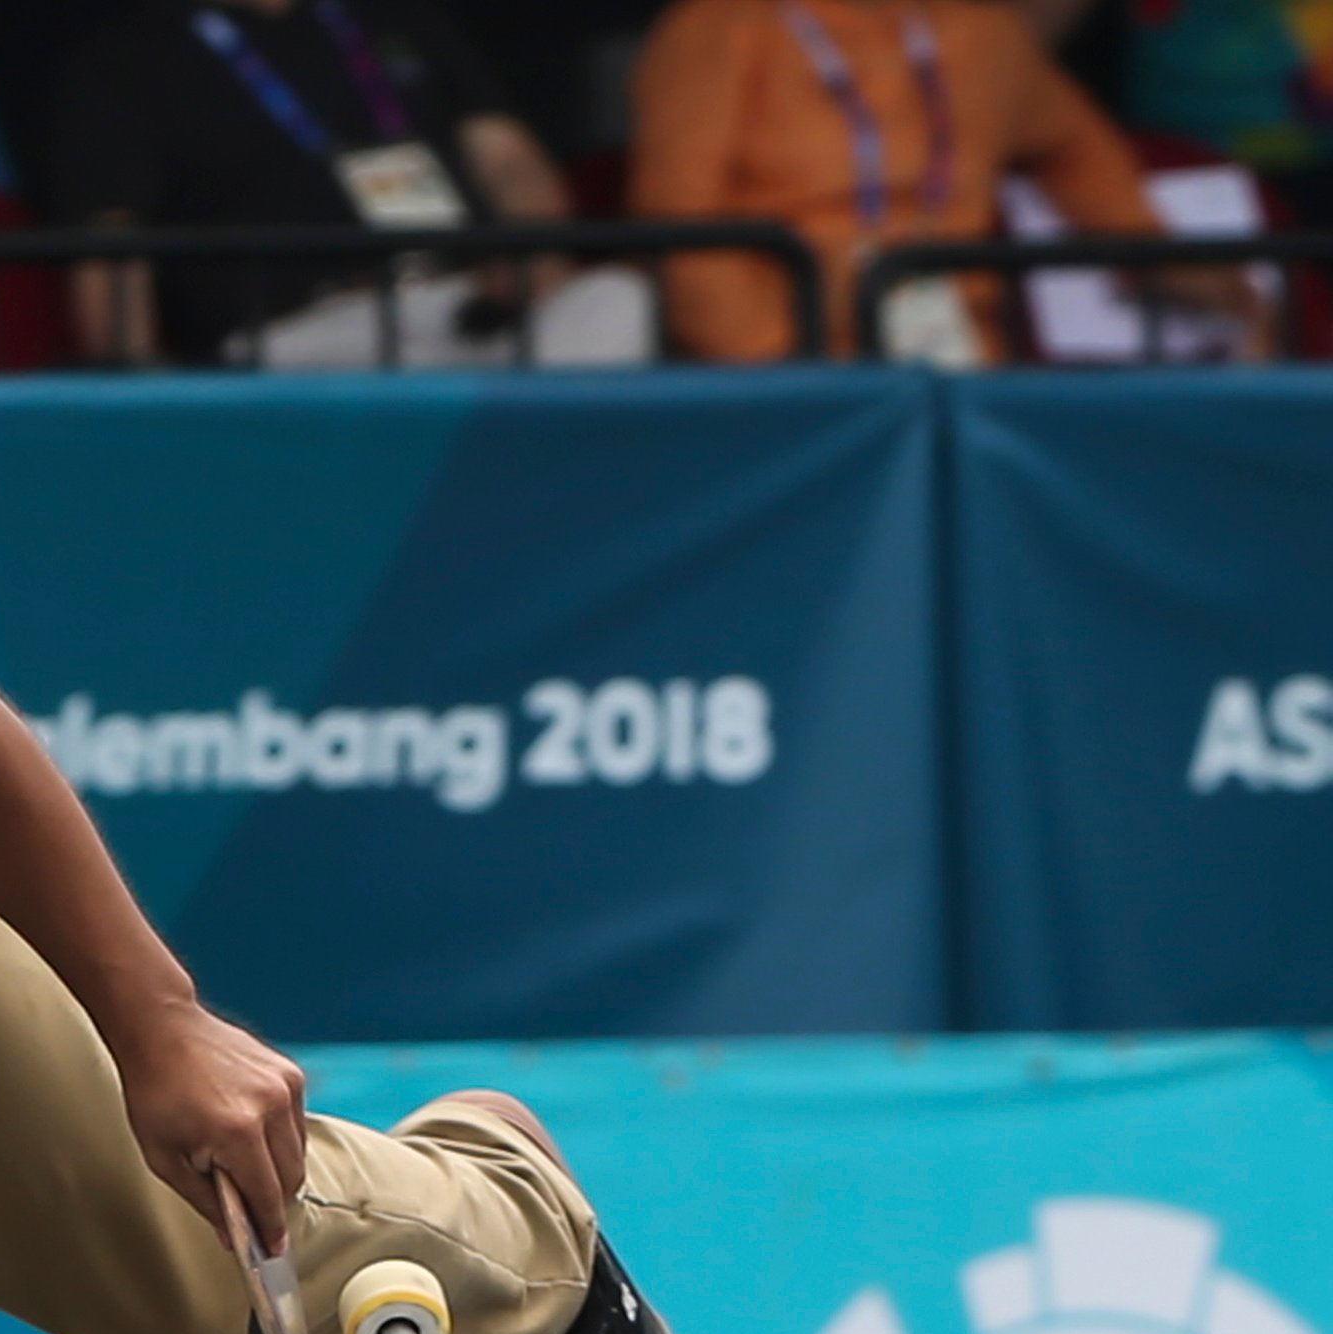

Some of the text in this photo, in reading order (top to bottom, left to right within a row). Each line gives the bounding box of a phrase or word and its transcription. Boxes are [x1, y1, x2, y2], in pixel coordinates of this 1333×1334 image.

[27, 676, 774, 812] lembang 2018
[1189, 674, 1333, 795] AS
